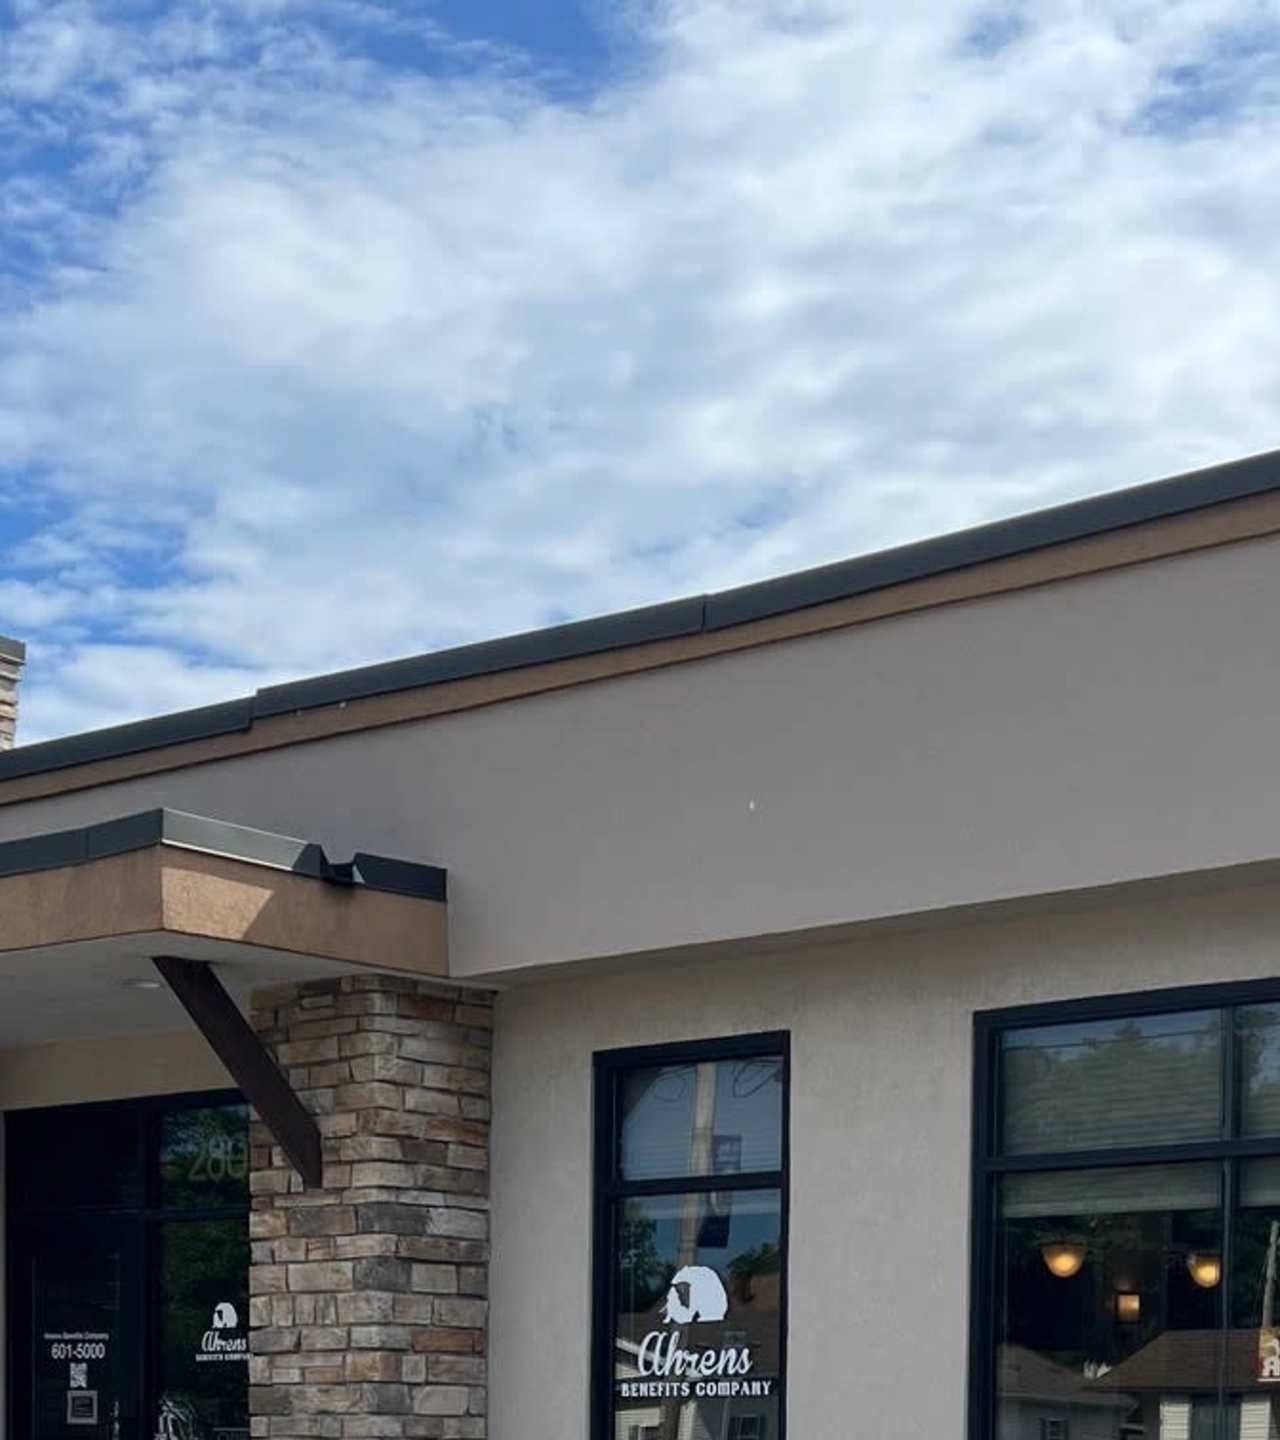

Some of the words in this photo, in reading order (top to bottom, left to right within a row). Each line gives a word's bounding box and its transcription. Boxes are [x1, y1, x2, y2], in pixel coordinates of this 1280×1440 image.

[51, 1342, 106, 1359] 601-5000
[638, 1331, 753, 1378] Ahrens
[621, 1382, 690, 1397] BENEFITS
[695, 1381, 772, 1396] COMPANY
